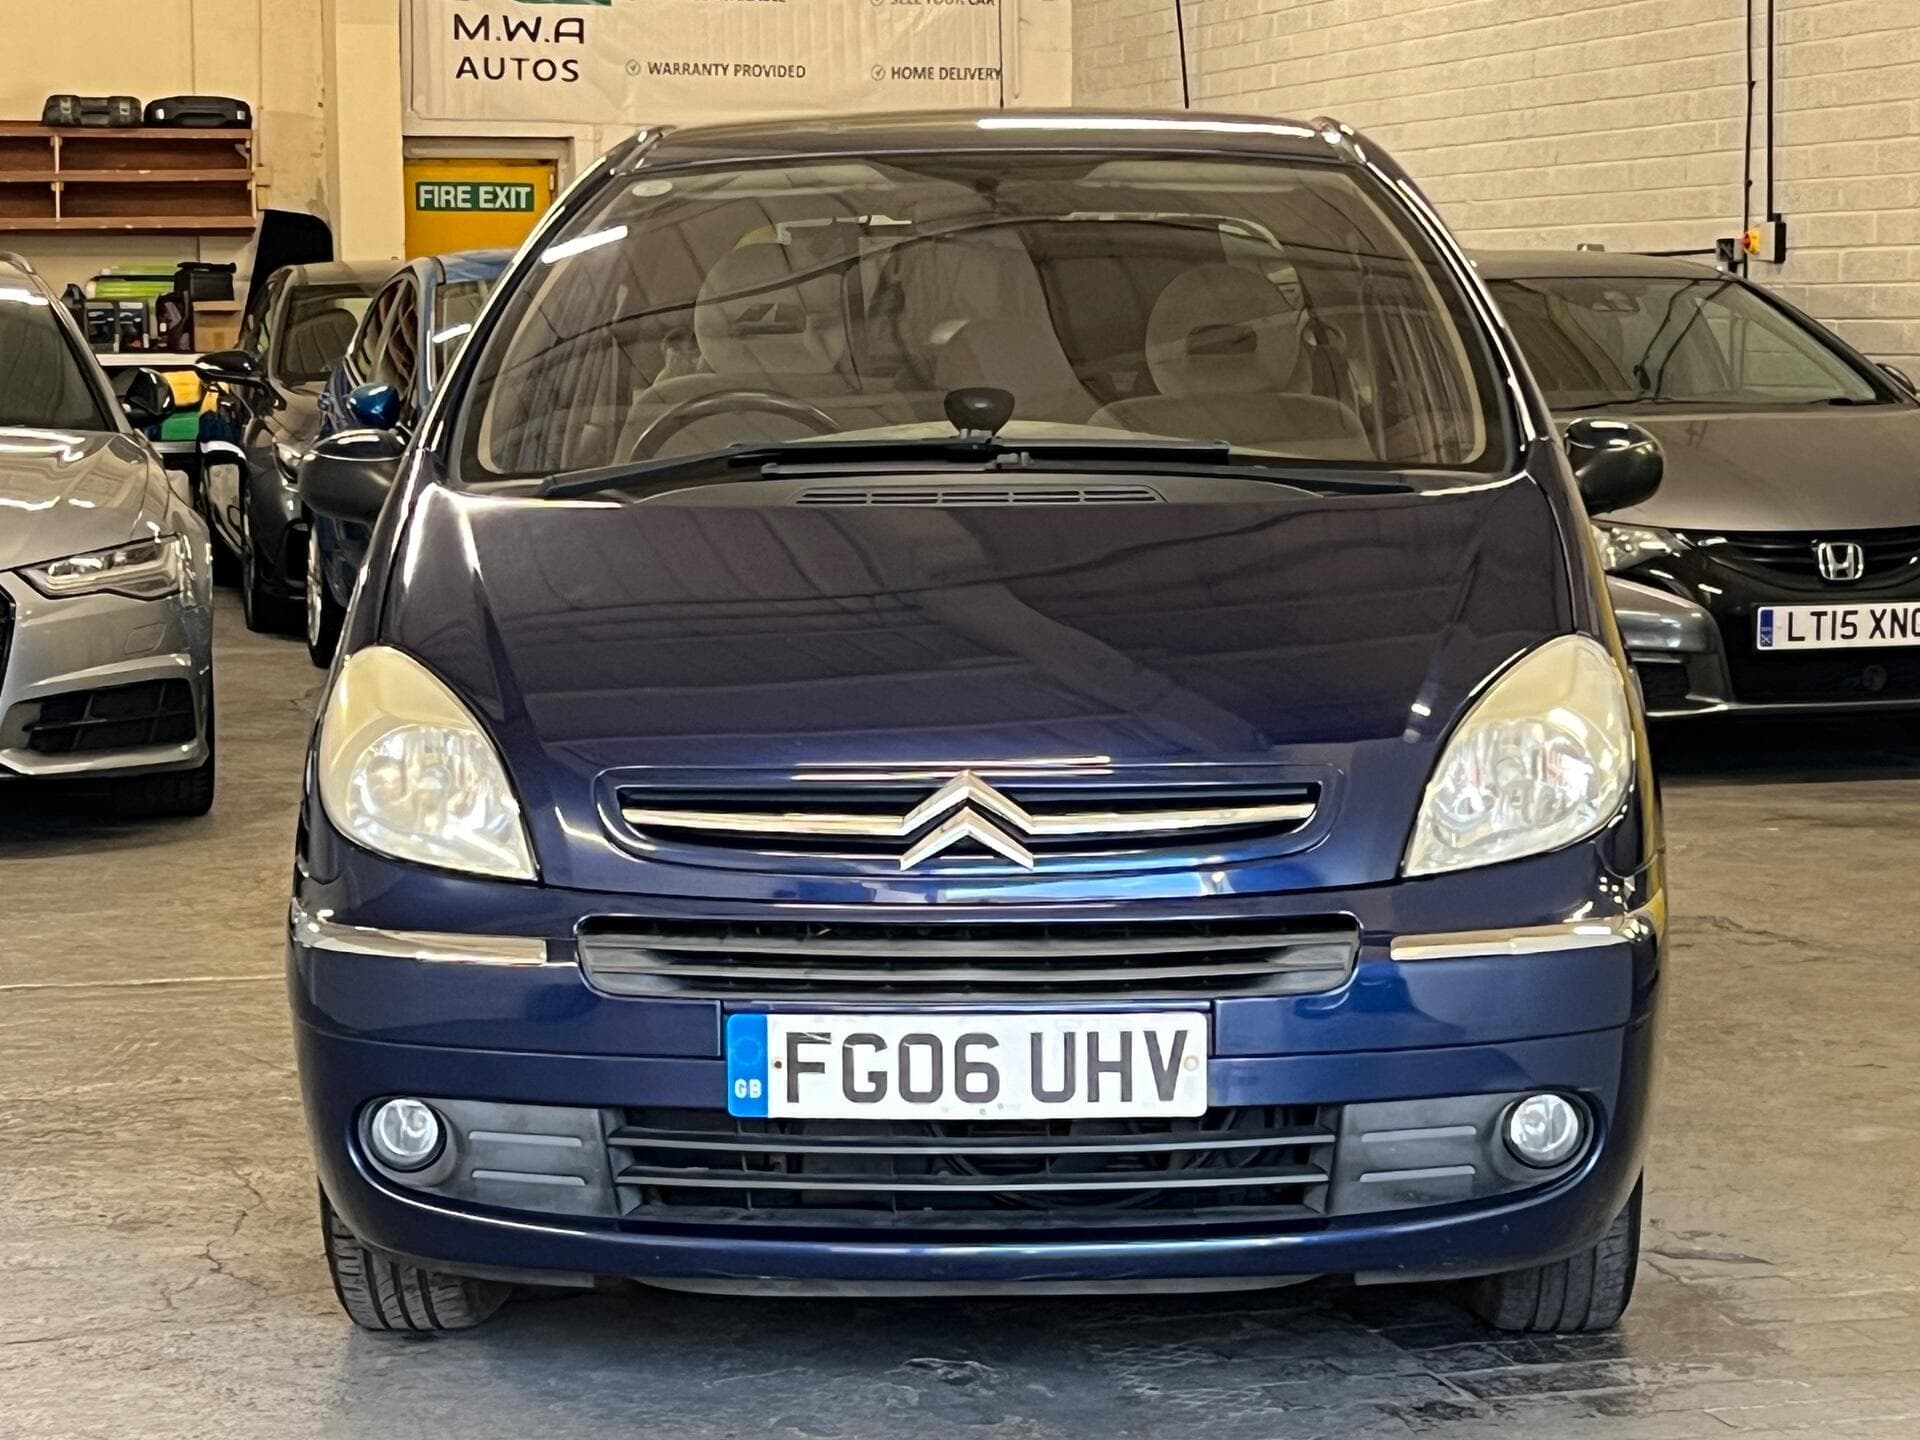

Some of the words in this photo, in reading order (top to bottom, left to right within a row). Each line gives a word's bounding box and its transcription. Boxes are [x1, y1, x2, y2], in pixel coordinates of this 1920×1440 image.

[454, 13, 585, 44] M.W.A
[455, 56, 579, 82] AUTOS
[648, 61, 729, 76] WARRANTY
[734, 64, 806, 78] PROVIDED
[891, 66, 934, 80] HOME
[939, 67, 1001, 80] DELIVERY
[419, 185, 472, 208] FIRE
[479, 186, 531, 209] EXIT
[1787, 610, 1859, 641] LT15
[786, 1032, 1000, 1103] FG06
[1031, 1030, 1188, 1103] UHV
[735, 1079, 761, 1098] GB
